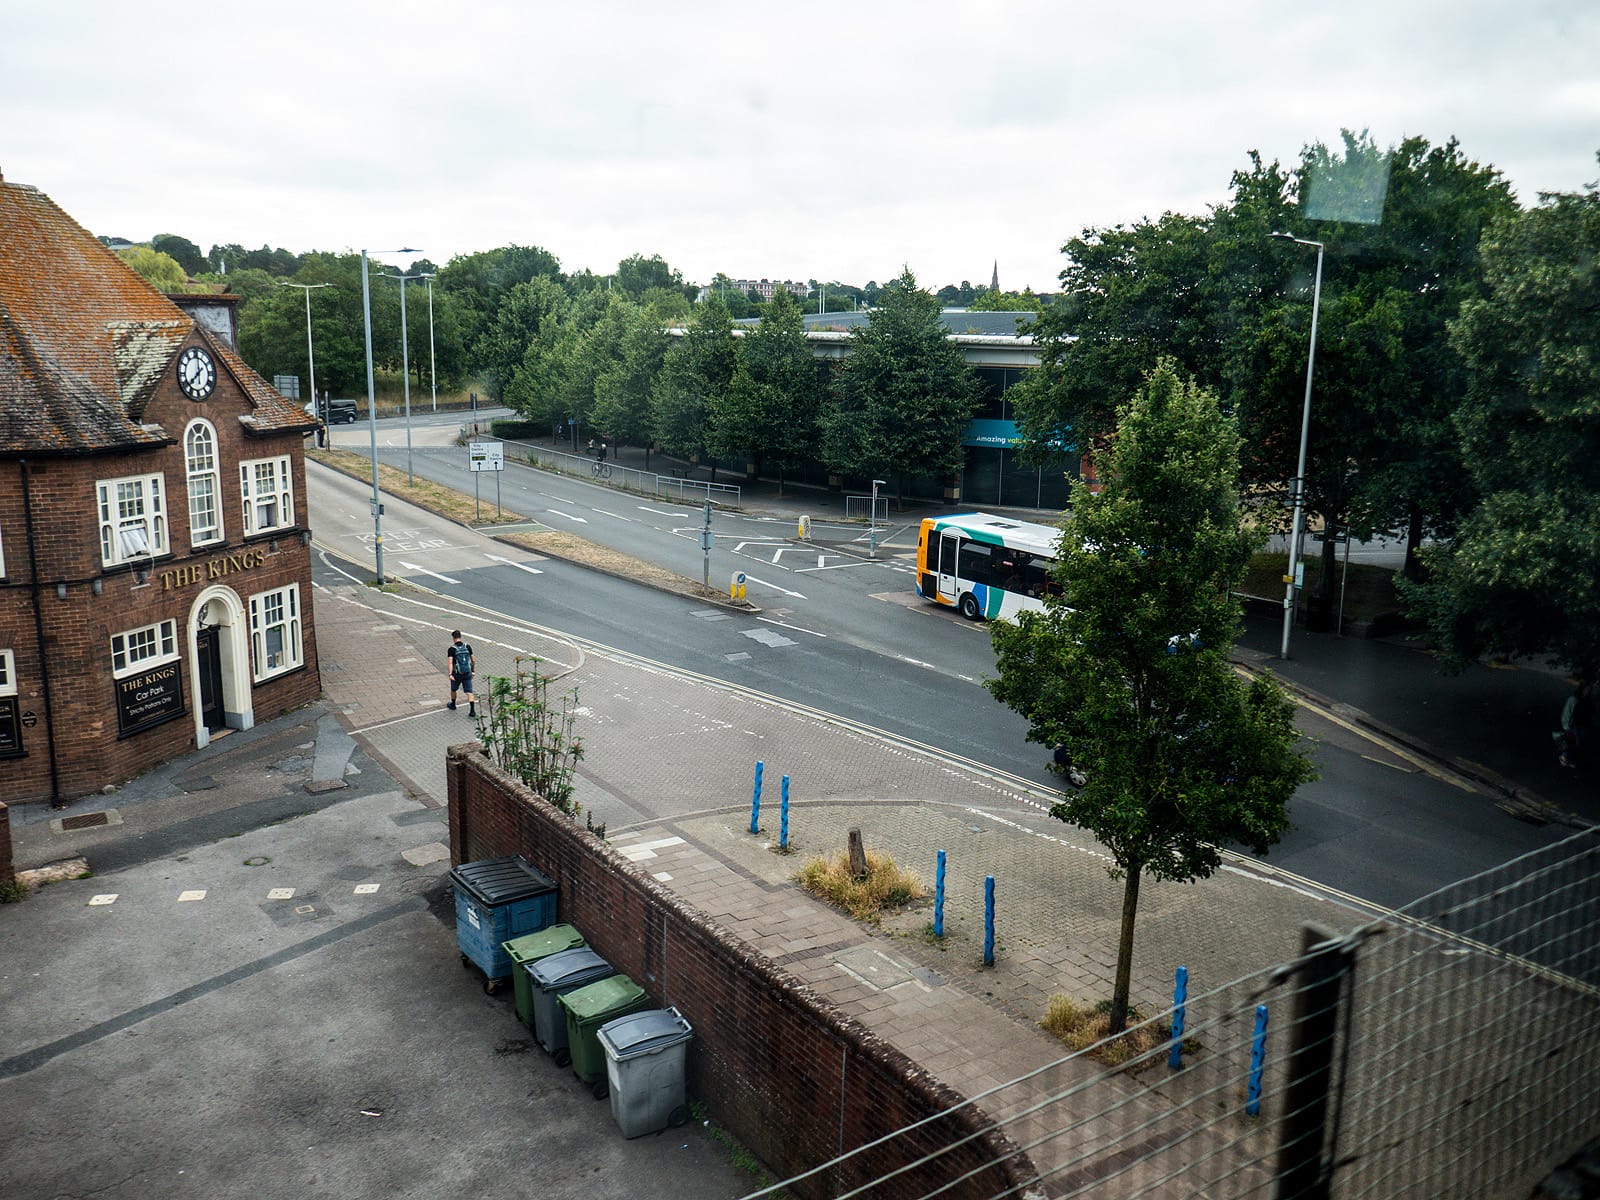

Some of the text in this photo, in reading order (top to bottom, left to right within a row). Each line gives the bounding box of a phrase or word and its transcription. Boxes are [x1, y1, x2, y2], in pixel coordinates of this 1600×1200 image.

[976, 435, 1006, 445] Amazing
[355, 530, 420, 543] KEEP
[364, 538, 453, 554] CLEAR
[160, 549, 265, 590] THE KINGS
[121, 667, 176, 692] THE KINGS
[135, 685, 165, 701] Car Park
[145, 700, 162, 710] Patrons
[161, 696, 172, 705] Only
